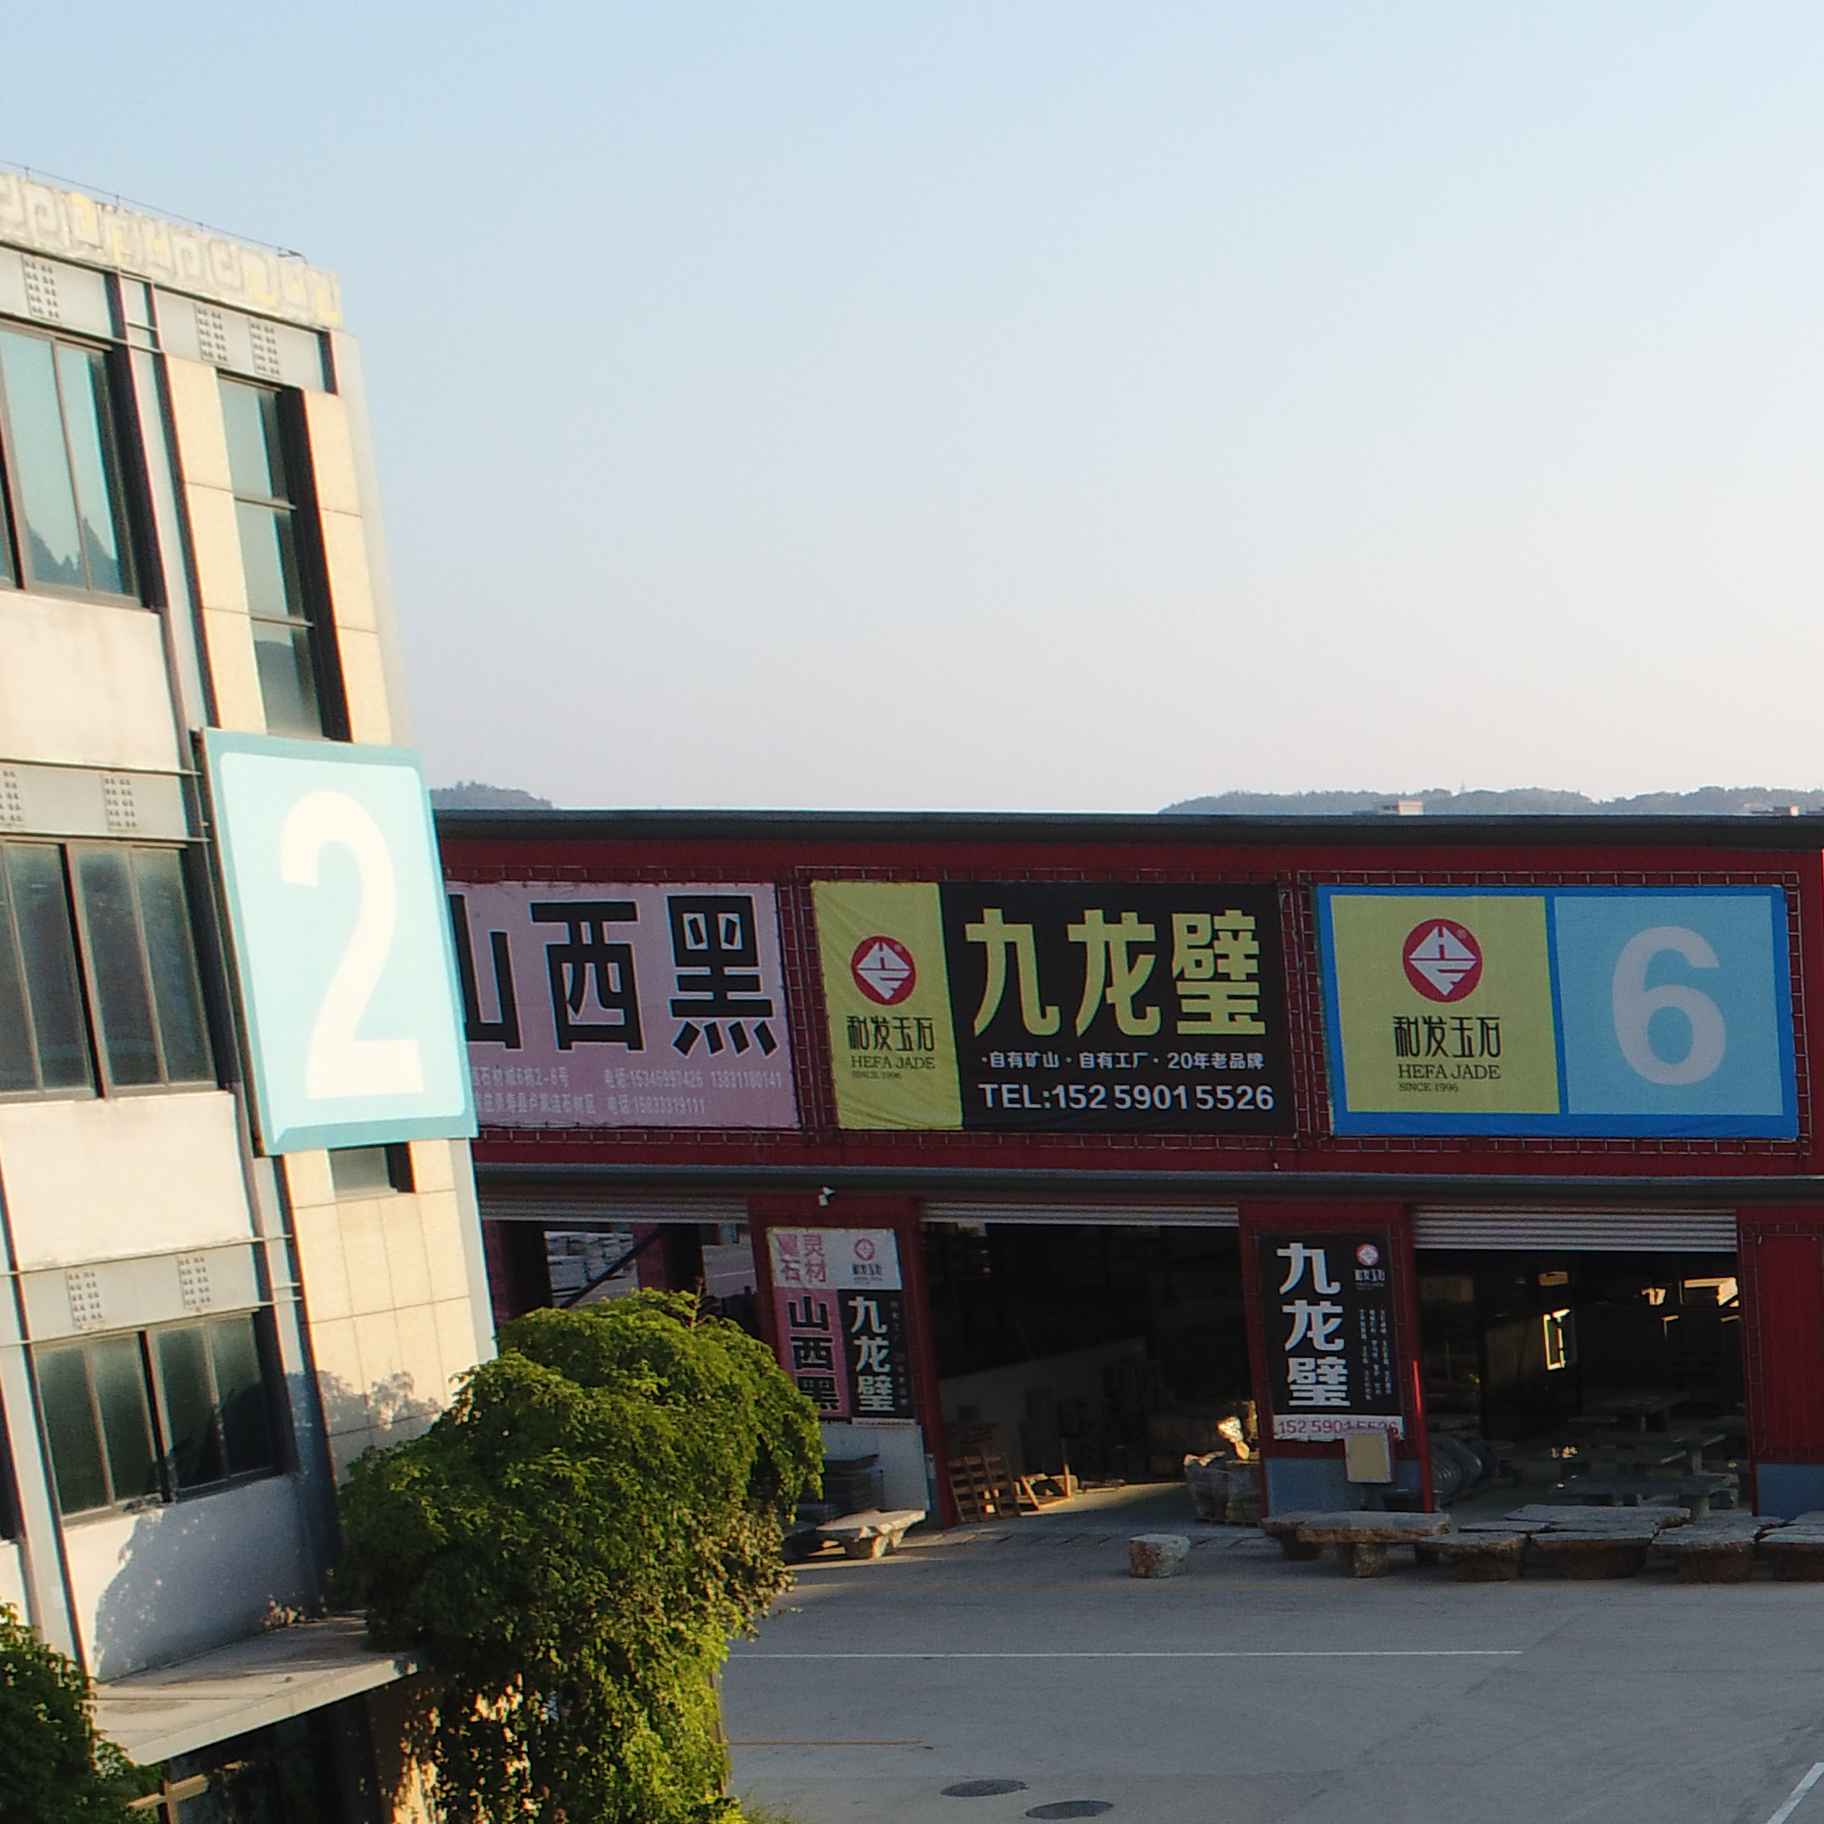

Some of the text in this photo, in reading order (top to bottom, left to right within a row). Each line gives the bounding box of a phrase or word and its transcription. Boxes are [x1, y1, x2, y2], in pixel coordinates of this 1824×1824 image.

[279, 790, 426, 1100] 2
[447, 893, 779, 1057] 山西黑
[1611, 925, 1727, 1086] 6
[846, 1016, 935, 1051] 和发玉石
[1392, 1015, 1501, 1058] 和发玉石
[851, 1055, 936, 1070] HEFA JADE
[1398, 1063, 1501, 1080] HEFA JADE
[978, 1083, 1273, 1111] TEL:152 5901 5526
[1399, 1082, 1432, 1092] SINCE
[1279, 1420, 1306, 1434] 152
